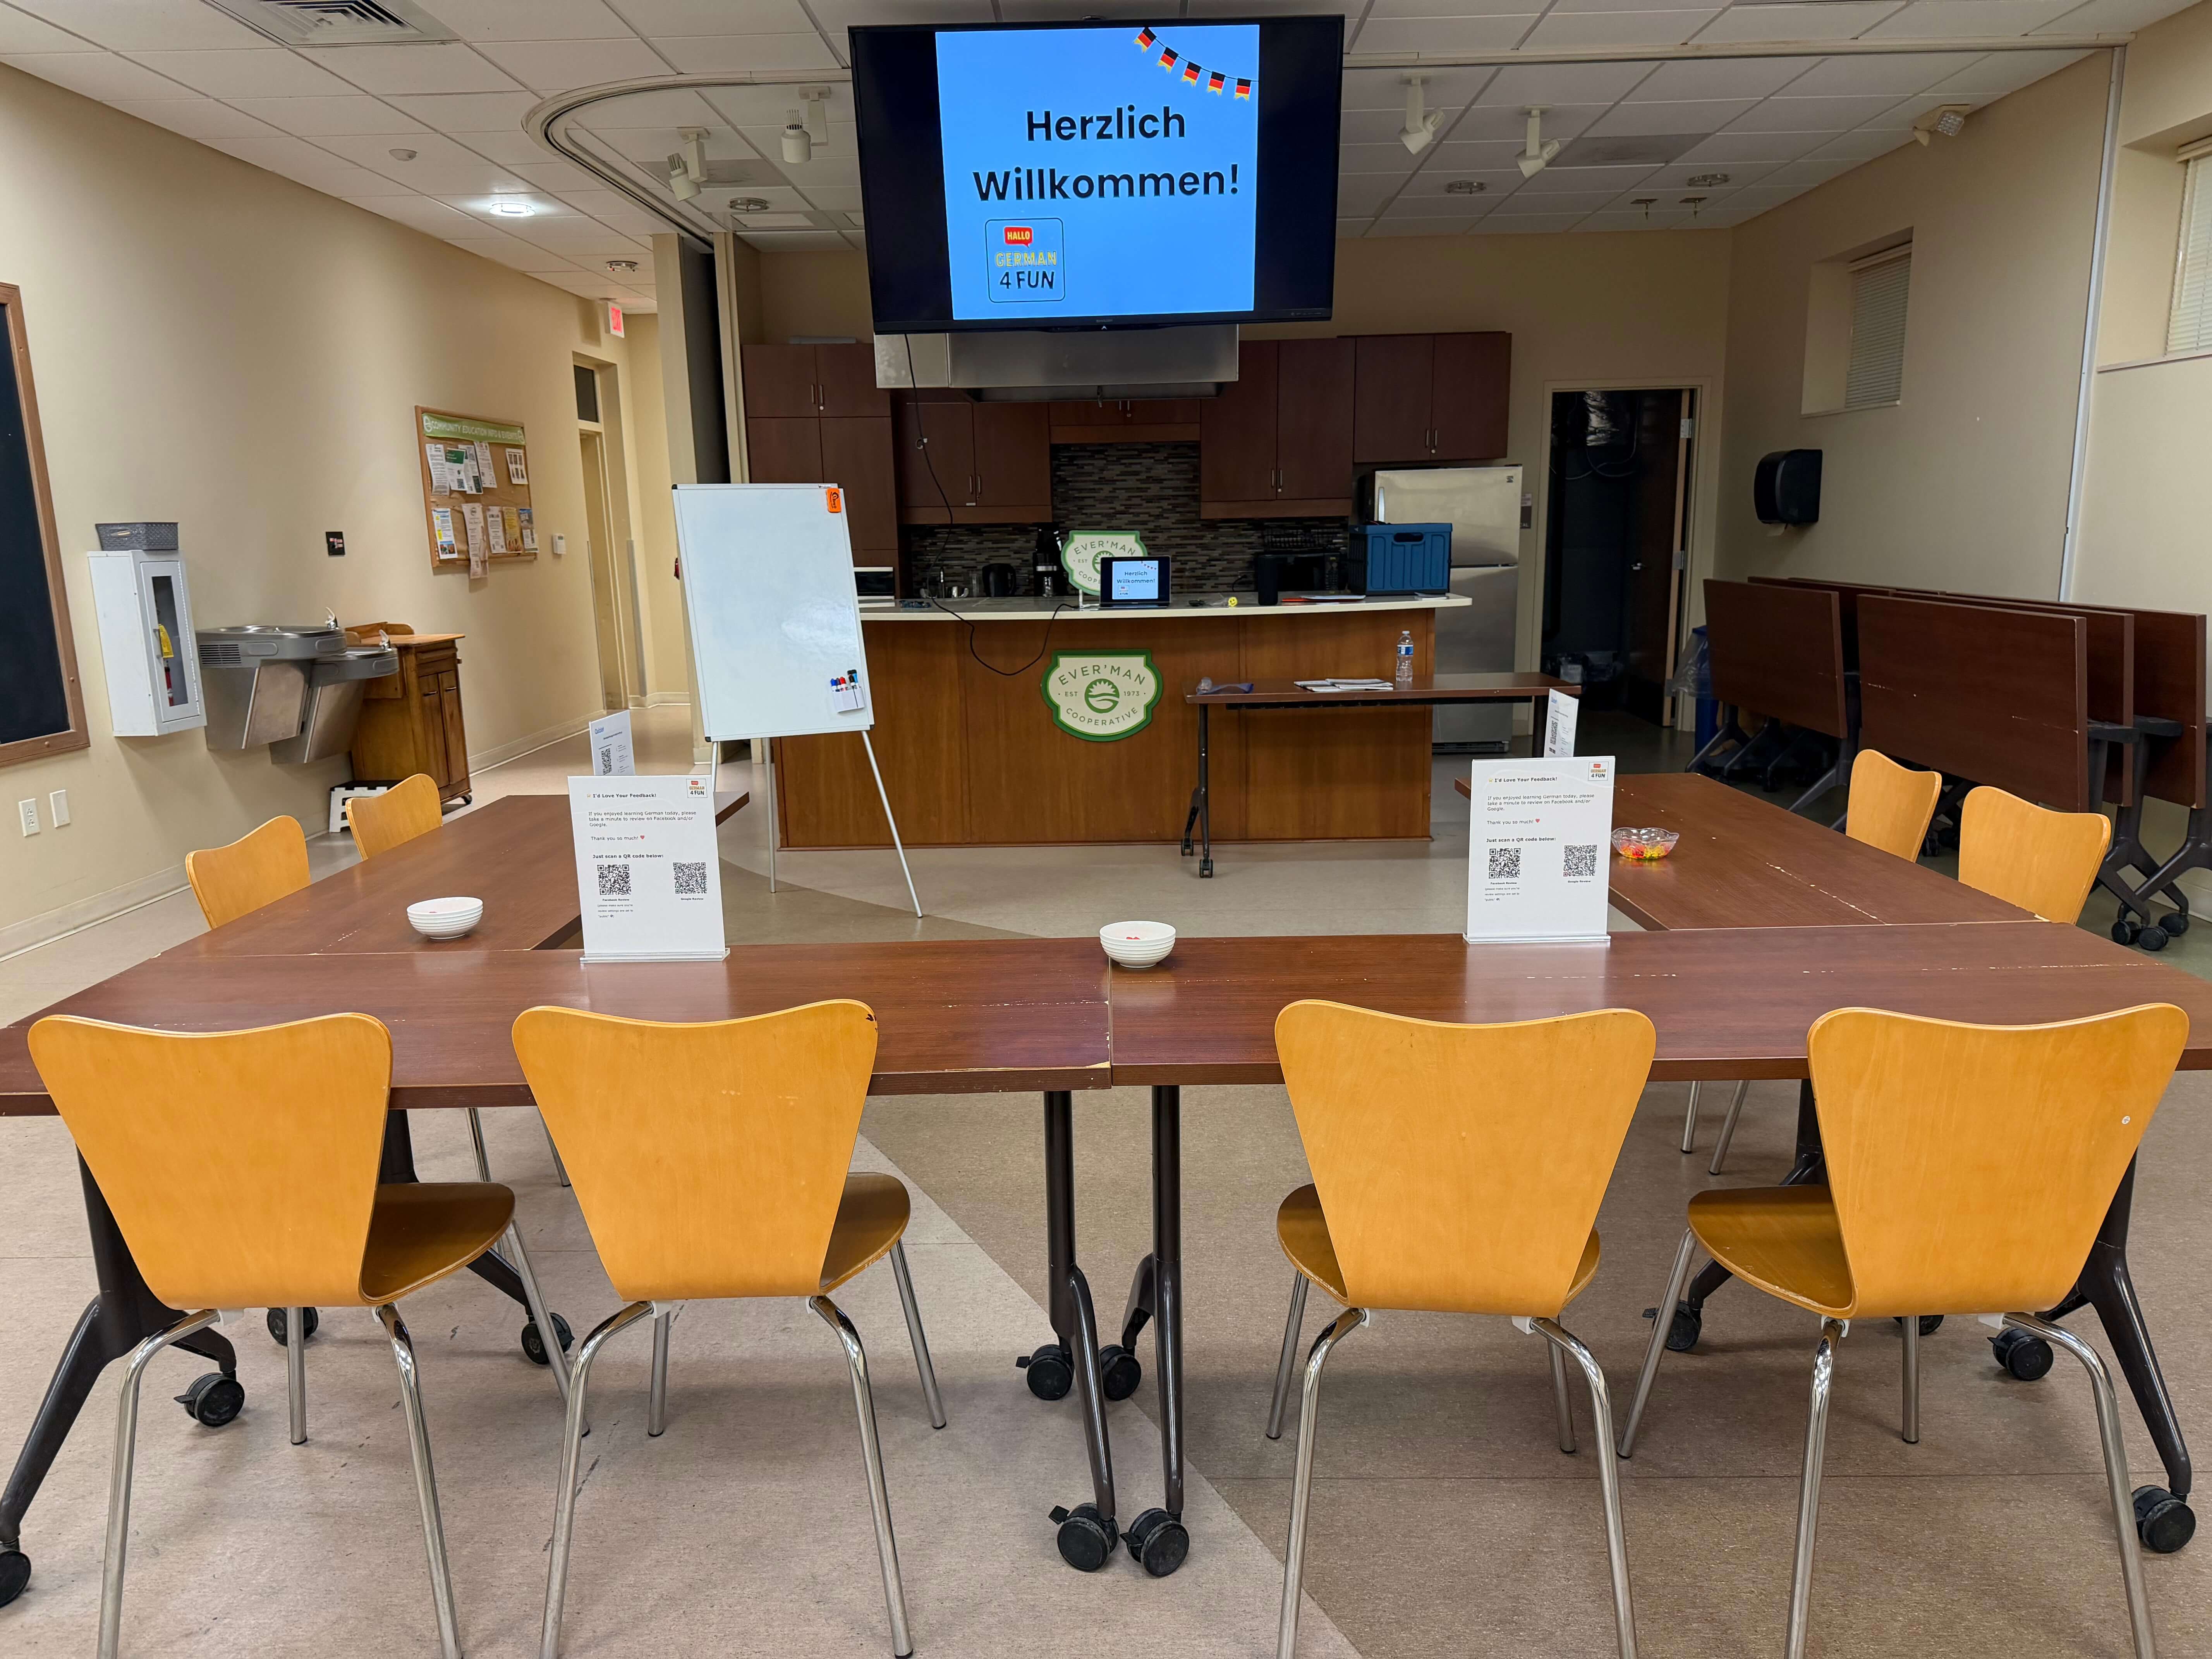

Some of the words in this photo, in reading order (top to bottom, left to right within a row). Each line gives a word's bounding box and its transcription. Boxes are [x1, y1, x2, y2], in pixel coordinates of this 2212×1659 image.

[1027, 104, 1185, 141] Herzlich
[972, 163, 1238, 201] Willkommen!
[1007, 231, 1030, 240] HALLO
[996, 251, 1057, 267] GERMAN
[1000, 271, 1011, 289] 4
[1016, 270, 1054, 289] FUN
[1074, 541, 1135, 555] EVER'MAN
[1058, 665, 1145, 685] EVER'MAN
[1066, 707, 1138, 725] COOPERATIVE
